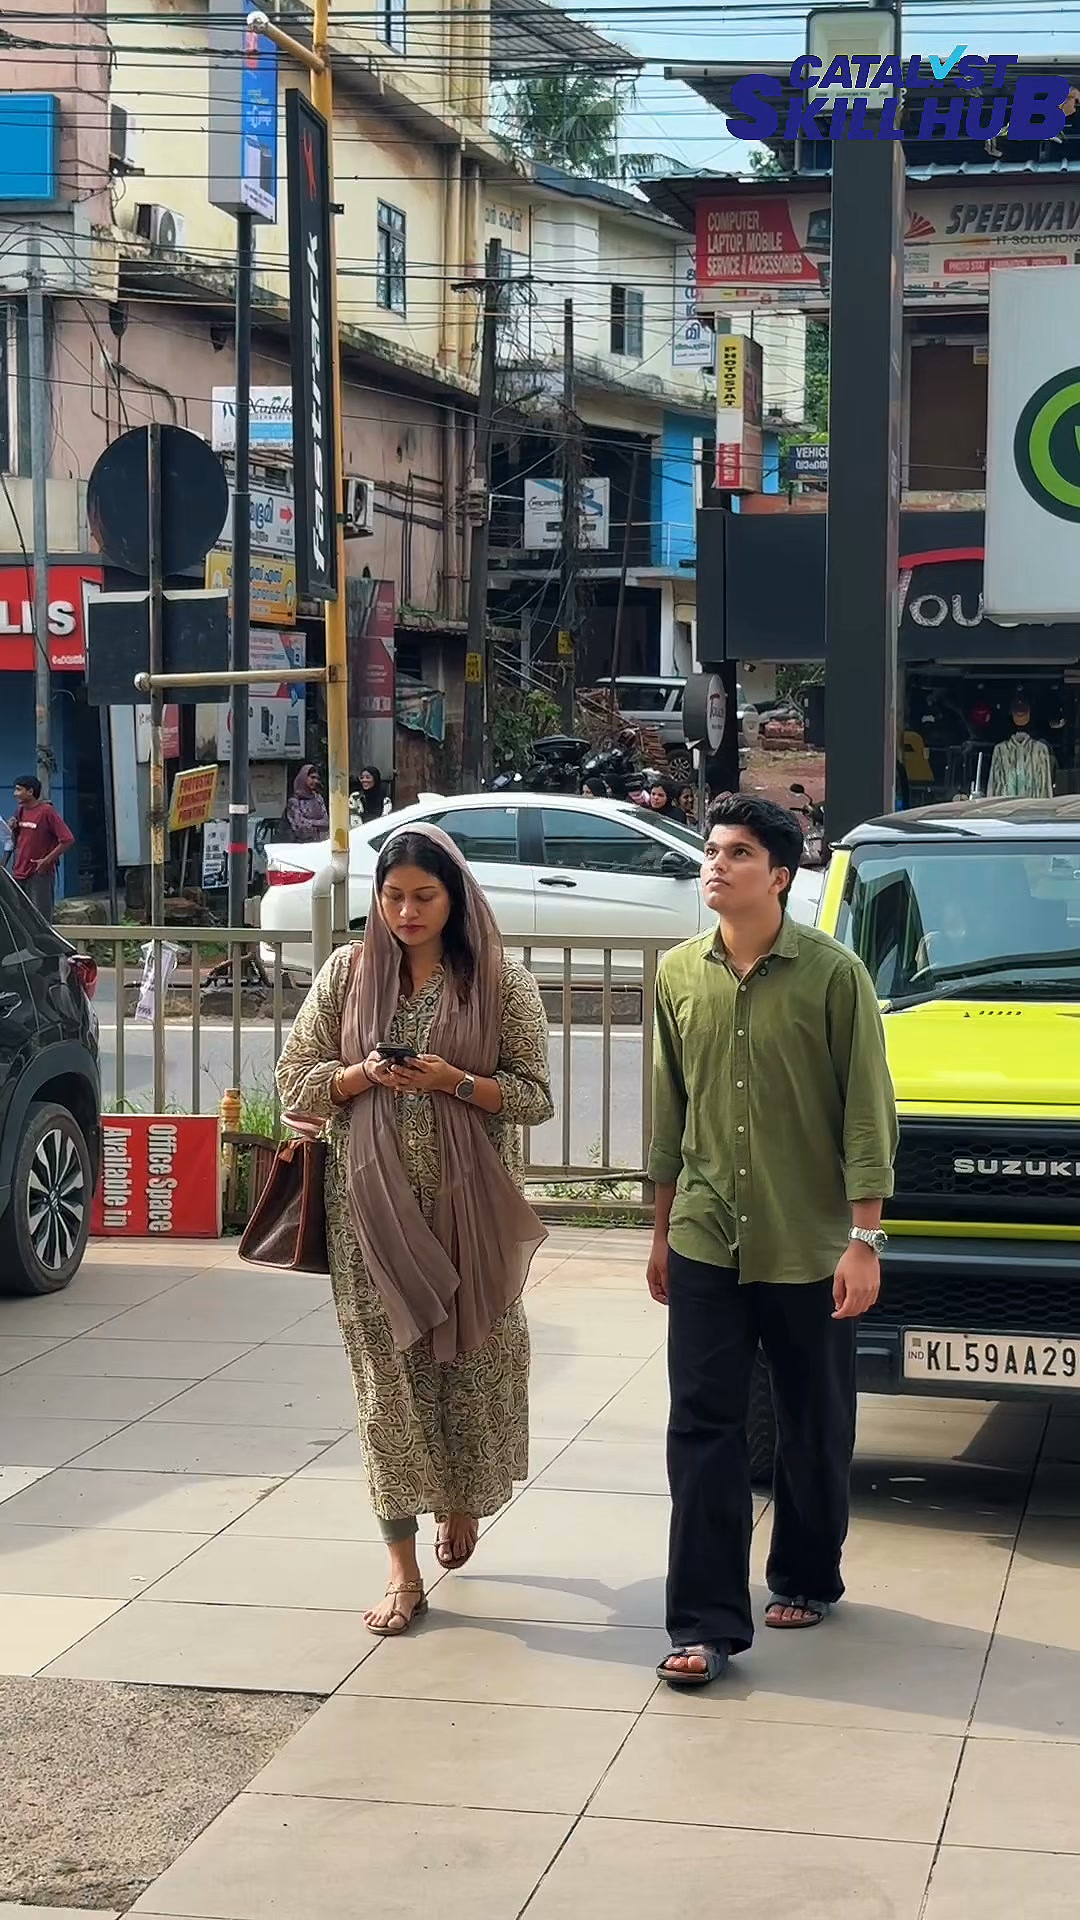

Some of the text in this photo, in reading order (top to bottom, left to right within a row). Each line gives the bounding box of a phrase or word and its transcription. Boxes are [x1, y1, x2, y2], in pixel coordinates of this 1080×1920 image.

[747, 232, 783, 252] MOBILE
[997, 234, 1080, 246] IT SOLUTION
[707, 253, 803, 277] SERVICE & ACCESSORIES
[723, 346, 737, 407] PHOTOSTAT
[103, 1125, 133, 1227] Available in
[145, 1124, 178, 1232] Office Space
[907, 1351, 924, 1360] IND
[926, 1340, 1077, 1378] KL59AA29
